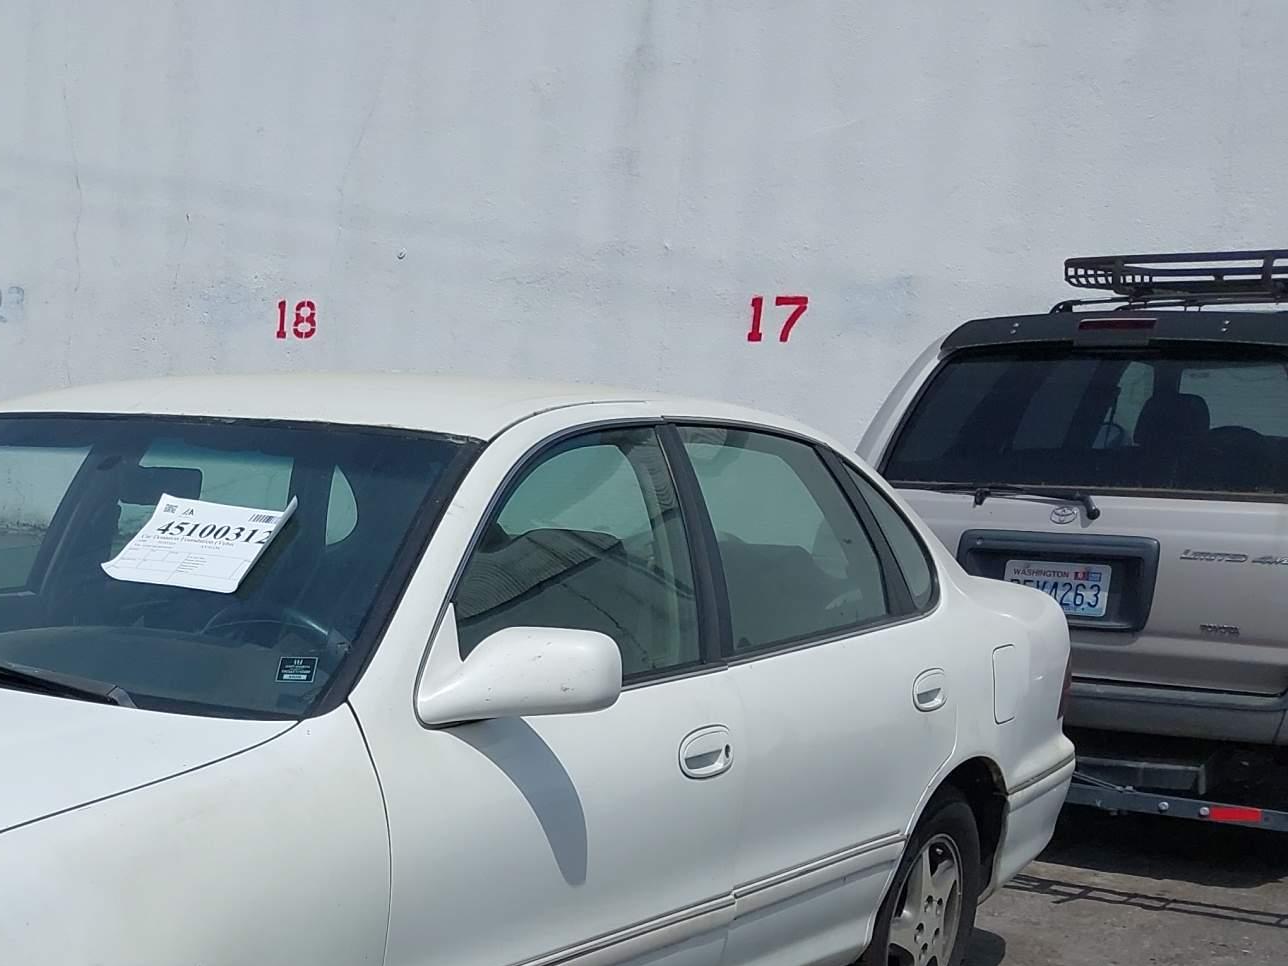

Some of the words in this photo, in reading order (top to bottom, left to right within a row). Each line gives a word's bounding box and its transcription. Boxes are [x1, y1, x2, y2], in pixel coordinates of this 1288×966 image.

[276, 300, 316, 339] 18
[748, 296, 808, 342] 17
[156, 520, 272, 544] 45100312
[1013, 568, 1069, 578] WASHINGTON
